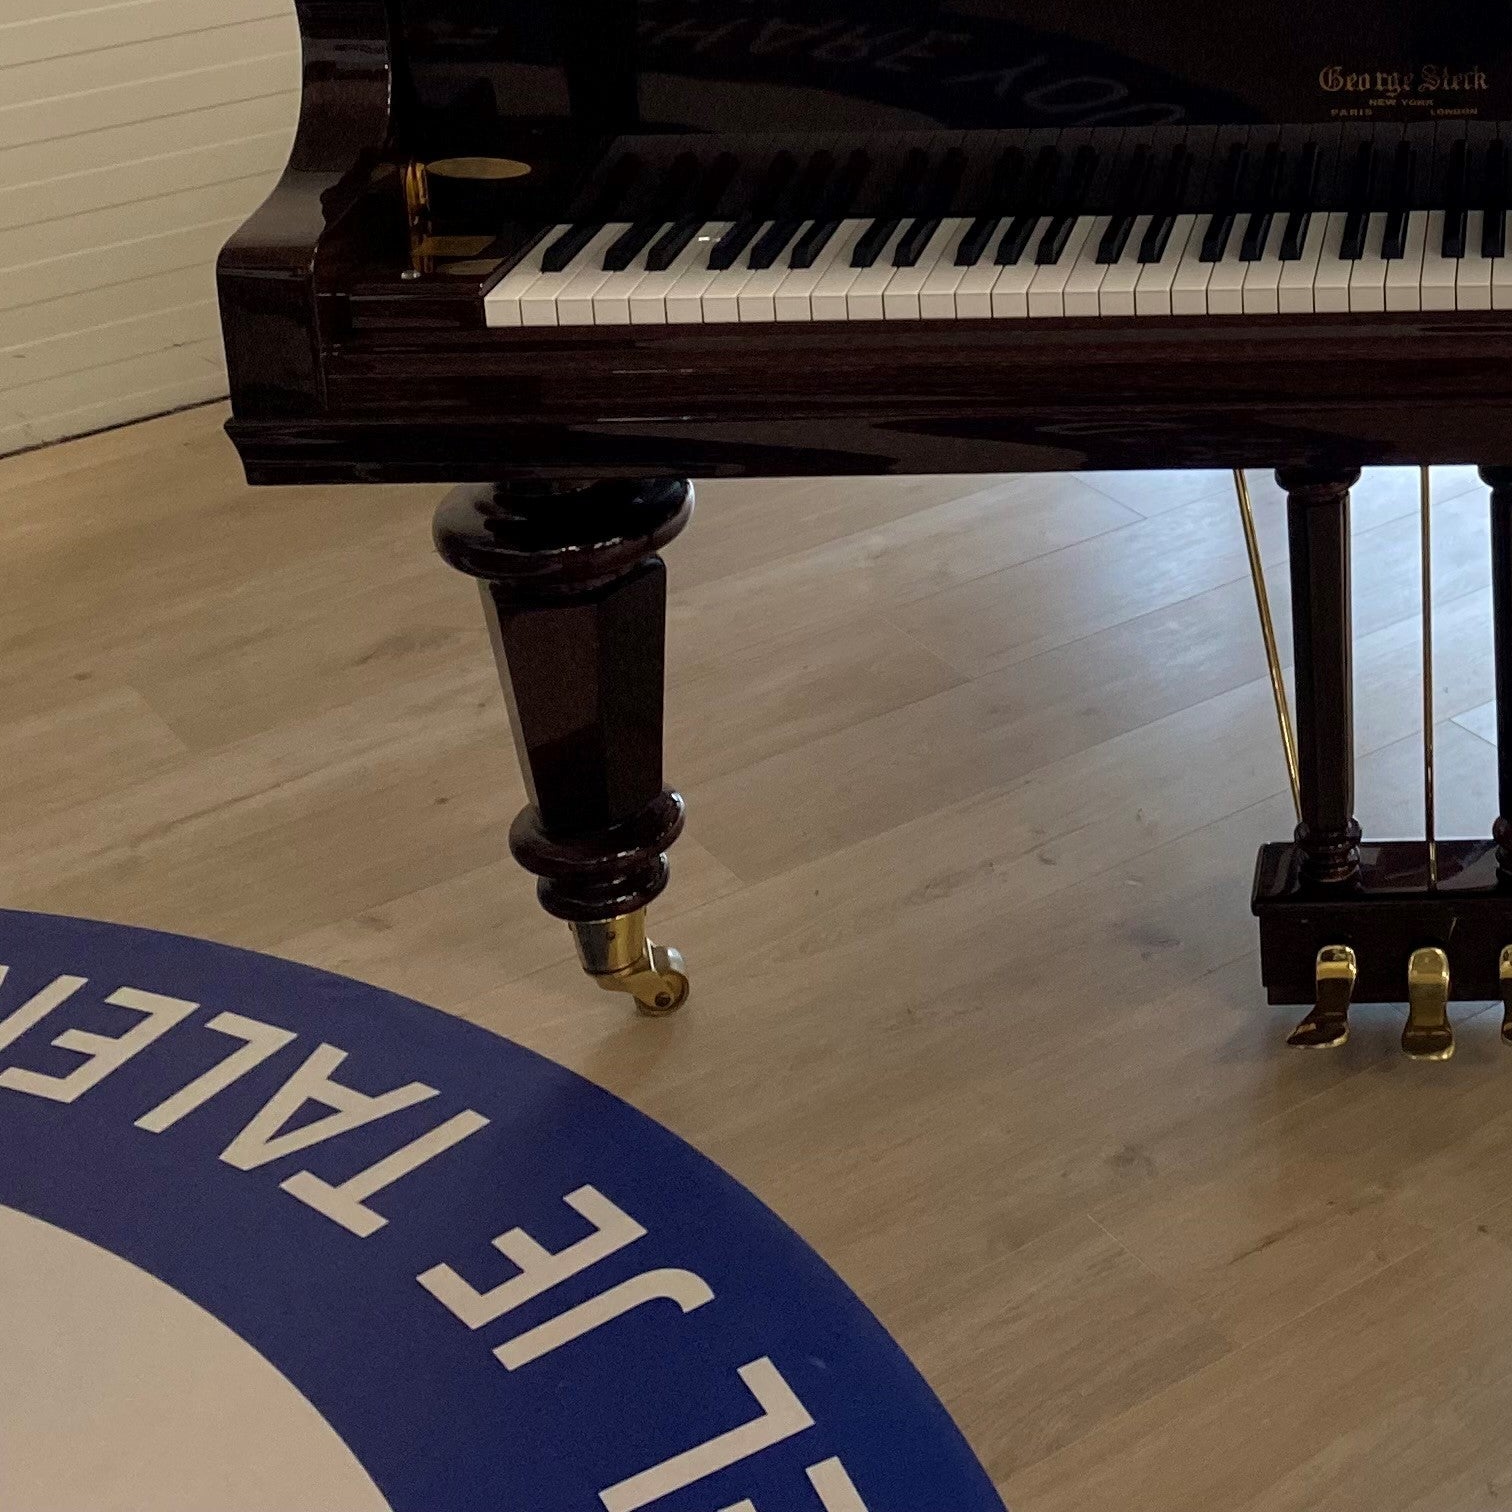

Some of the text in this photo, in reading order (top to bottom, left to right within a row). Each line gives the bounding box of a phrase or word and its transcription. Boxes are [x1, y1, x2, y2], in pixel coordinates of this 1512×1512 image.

[1318, 63, 1490, 97] George Steck
[416, 1184, 715, 1371] JE
